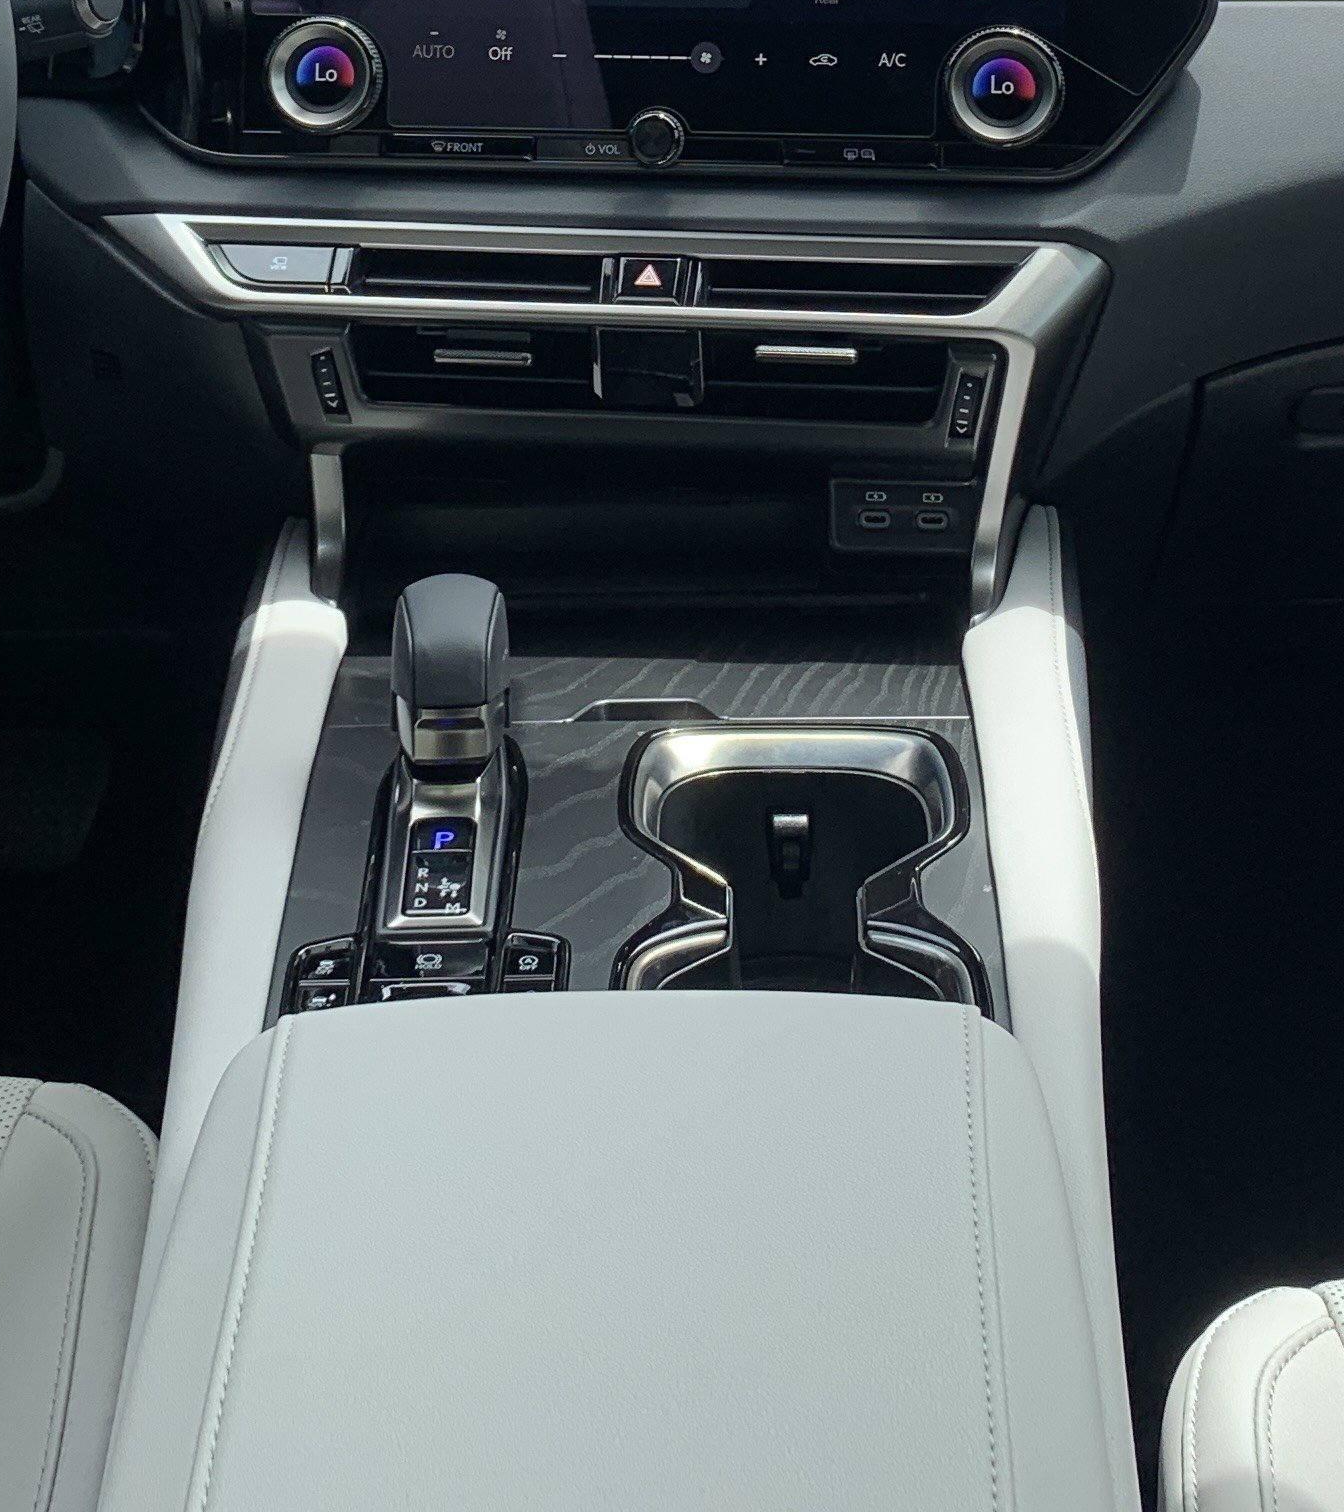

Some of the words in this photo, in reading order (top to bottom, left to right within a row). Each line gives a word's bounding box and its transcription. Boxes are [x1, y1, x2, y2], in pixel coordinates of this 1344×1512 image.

[412, 45, 455, 60] AUTO
[488, 46, 513, 62] Off
[878, 53, 907, 68] A/C
[314, 63, 338, 83] Lo
[990, 75, 1015, 96] Lo
[447, 142, 484, 154] FRONT
[598, 144, 621, 155] VOL
[433, 831, 455, 850] P
[417, 867, 430, 879] R
[415, 882, 429, 893] N
[414, 897, 428, 908] D
[445, 902, 461, 914] M
[414, 962, 443, 970] HOLD
